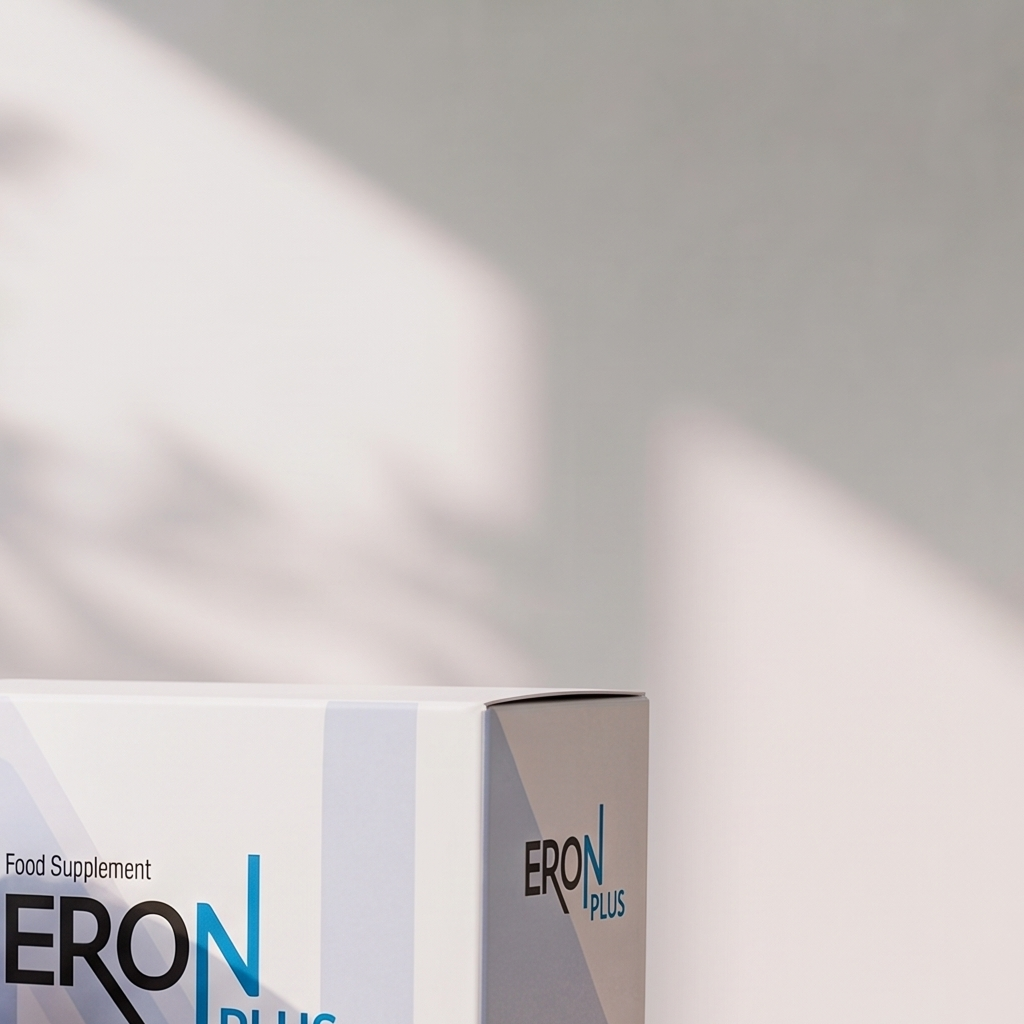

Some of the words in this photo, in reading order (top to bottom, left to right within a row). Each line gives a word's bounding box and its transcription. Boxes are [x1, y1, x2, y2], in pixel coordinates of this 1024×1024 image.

[5, 853, 45, 876] Food
[51, 854, 151, 883] Supplement
[525, 804, 604, 914] ERON
[591, 889, 625, 921] PLUS
